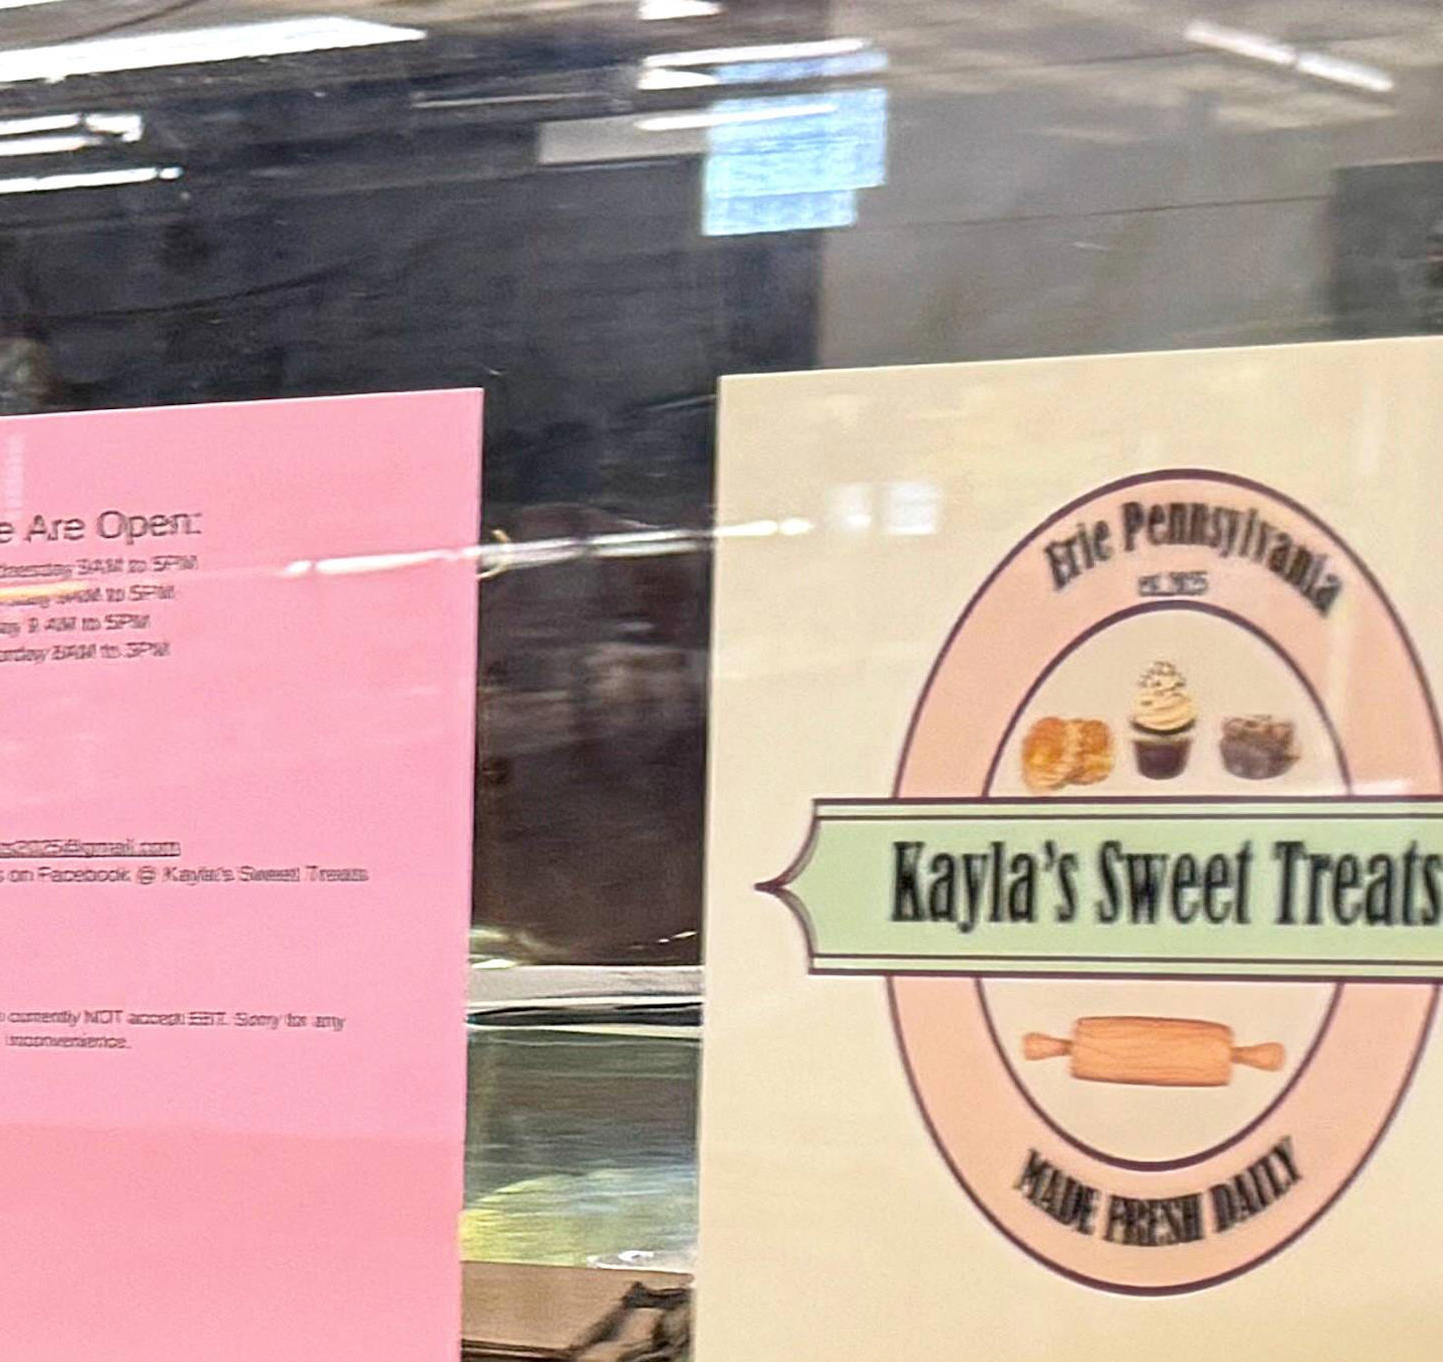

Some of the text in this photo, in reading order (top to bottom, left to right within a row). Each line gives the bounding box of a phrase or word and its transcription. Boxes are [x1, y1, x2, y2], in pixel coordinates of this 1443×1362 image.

[25, 514, 86, 543] Are
[96, 509, 202, 546] Open:
[1043, 501, 1342, 618] Erie Pennsylvania
[8, 868, 34, 884] on
[38, 865, 131, 883] Facebook
[238, 865, 300, 883] Sweet
[305, 864, 369, 883] Treats
[890, 839, 1443, 934] Kayla's Sweet Treats
[84, 1009, 123, 1025] NOT
[233, 1011, 279, 1030] Sorry
[1012, 1134, 1303, 1248] MADE FRESH DAILY
